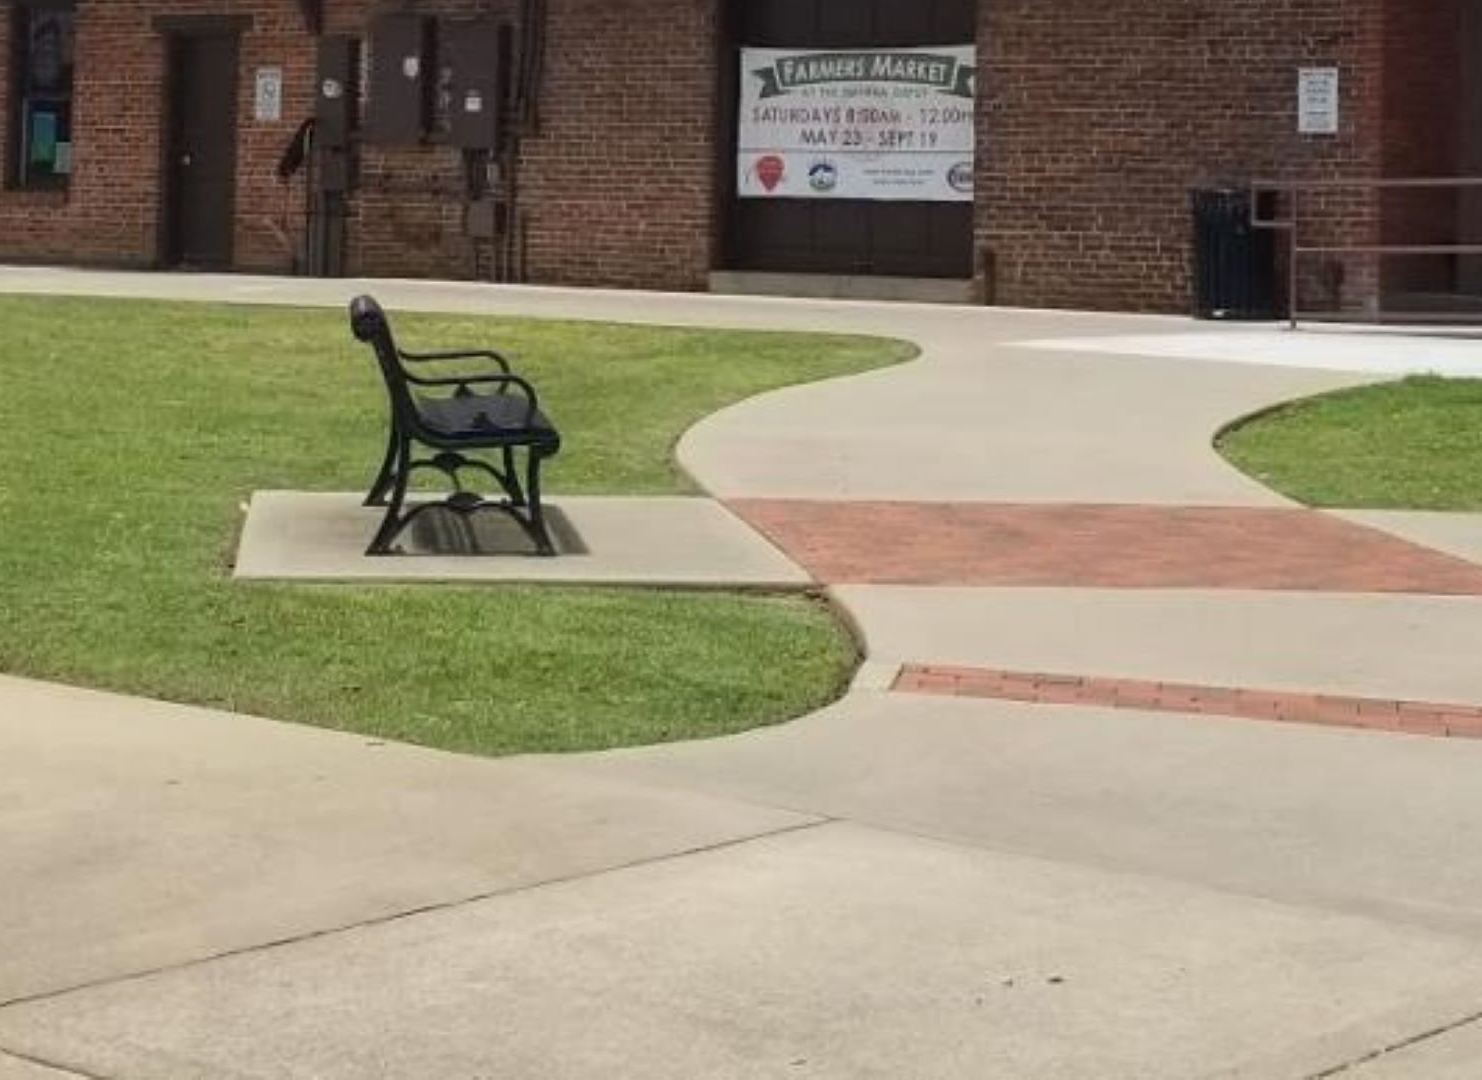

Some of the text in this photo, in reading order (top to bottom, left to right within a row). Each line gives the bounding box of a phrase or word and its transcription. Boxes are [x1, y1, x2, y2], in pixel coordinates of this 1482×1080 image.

[782, 54, 948, 82] FARMERS MARKET
[752, 106, 841, 124] SATURDAYS
[800, 128, 838, 146] MAY
[841, 129, 863, 146] 23
[878, 129, 914, 147] SEPT
